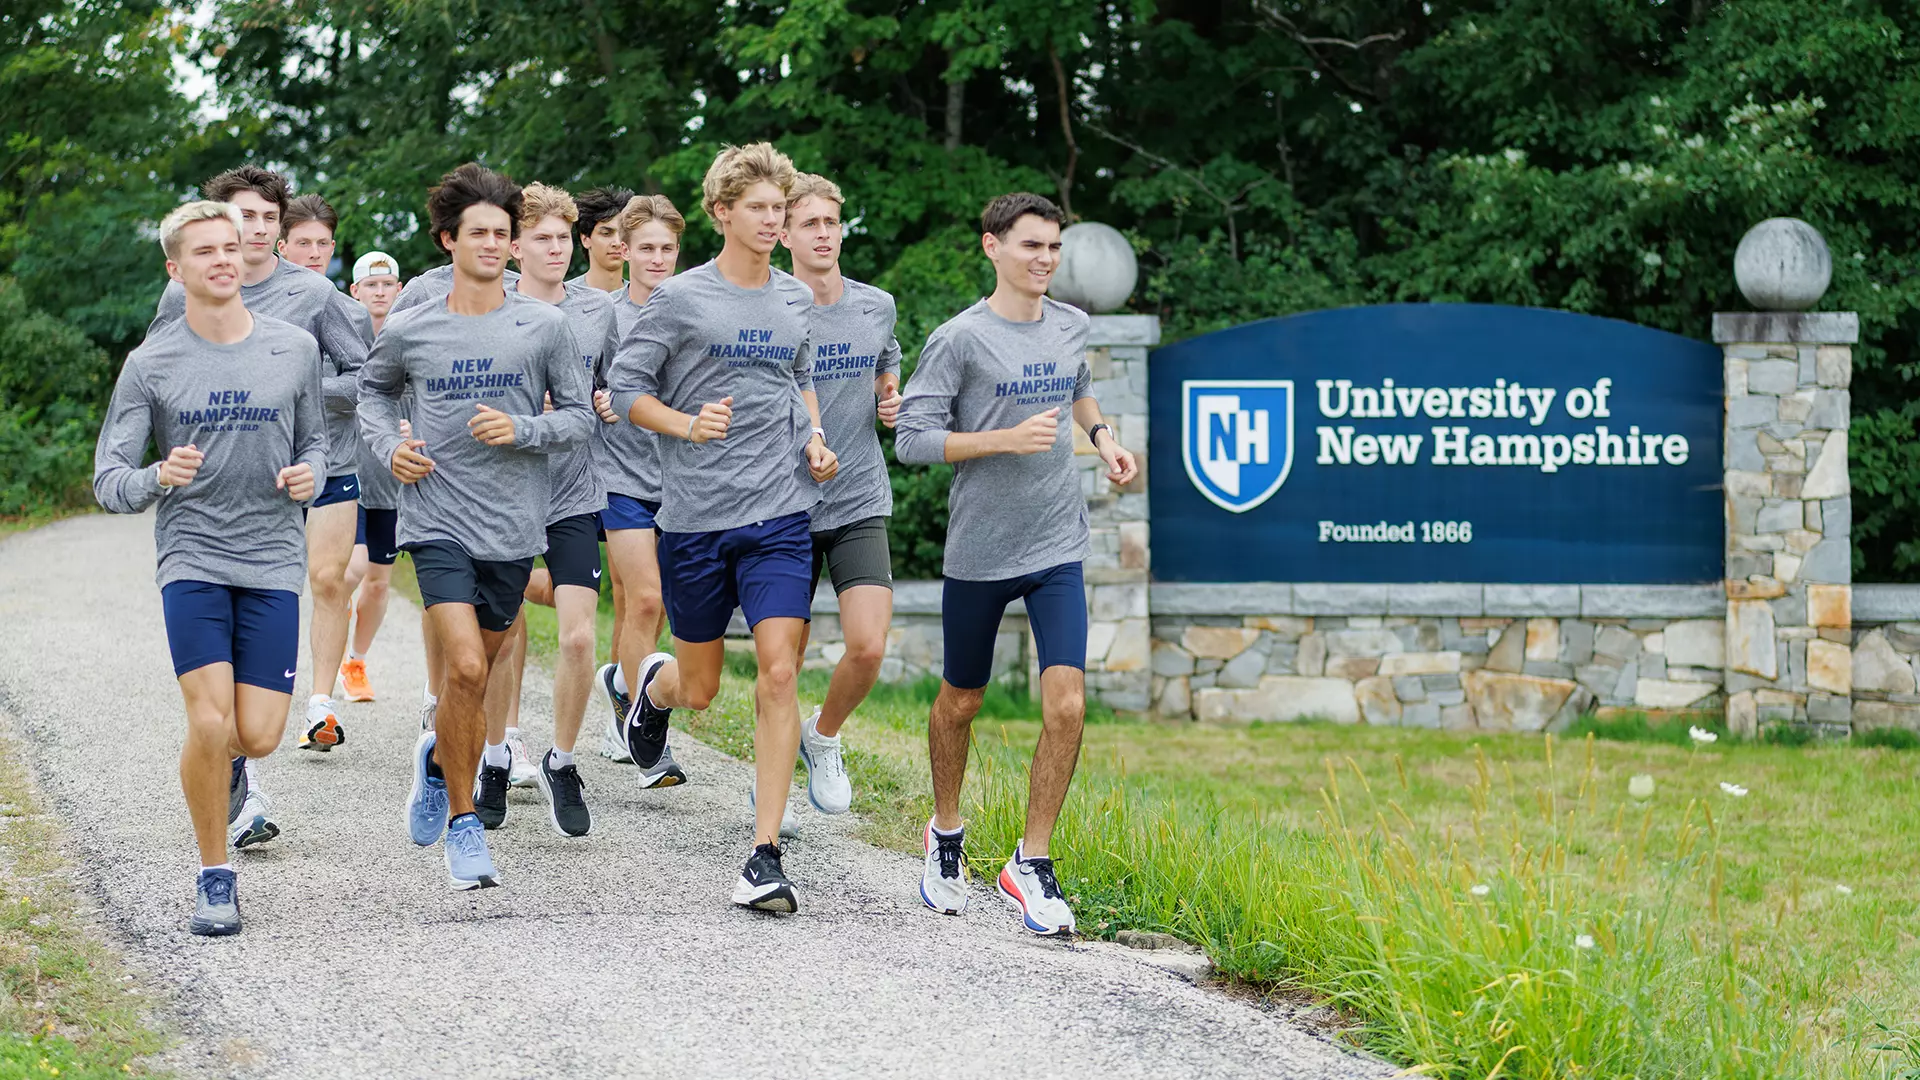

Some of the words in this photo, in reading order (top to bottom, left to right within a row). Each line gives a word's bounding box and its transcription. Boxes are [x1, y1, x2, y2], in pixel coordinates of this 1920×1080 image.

[738, 329, 773, 343] NEW
[709, 344, 796, 361] HAMPSHIRE
[817, 343, 851, 357] NEW
[452, 358, 494, 374] NEW
[728, 360, 751, 368] TRACK
[758, 361, 780, 369] FIELD
[813, 355, 876, 373] MPSHIRE
[1023, 362, 1056, 378] NEW
[426, 372, 523, 392] HAMPSHIRE
[812, 373, 834, 382] TRACK
[842, 371, 861, 379] FIELD
[208, 390, 251, 405] NEW
[444, 391, 471, 401] TRACK
[473, 391, 480, 399] &
[481, 389, 505, 398] FIELD
[1016, 396, 1039, 406] TRACK
[1047, 394, 1066, 403] FIELD
[1315, 377, 1557, 426] University
[1565, 377, 1612, 419] of
[179, 406, 280, 425] HAMPSHIRE
[200, 424, 226, 433] TRACK
[227, 424, 234, 432] &
[235, 423, 259, 432] FIELD
[1209, 409, 1270, 465] NH
[1315, 425, 1424, 465] New
[1431, 425, 1690, 473] Hampshire
[1318, 520, 1416, 543] Founded
[1420, 520, 1473, 543] 1866
